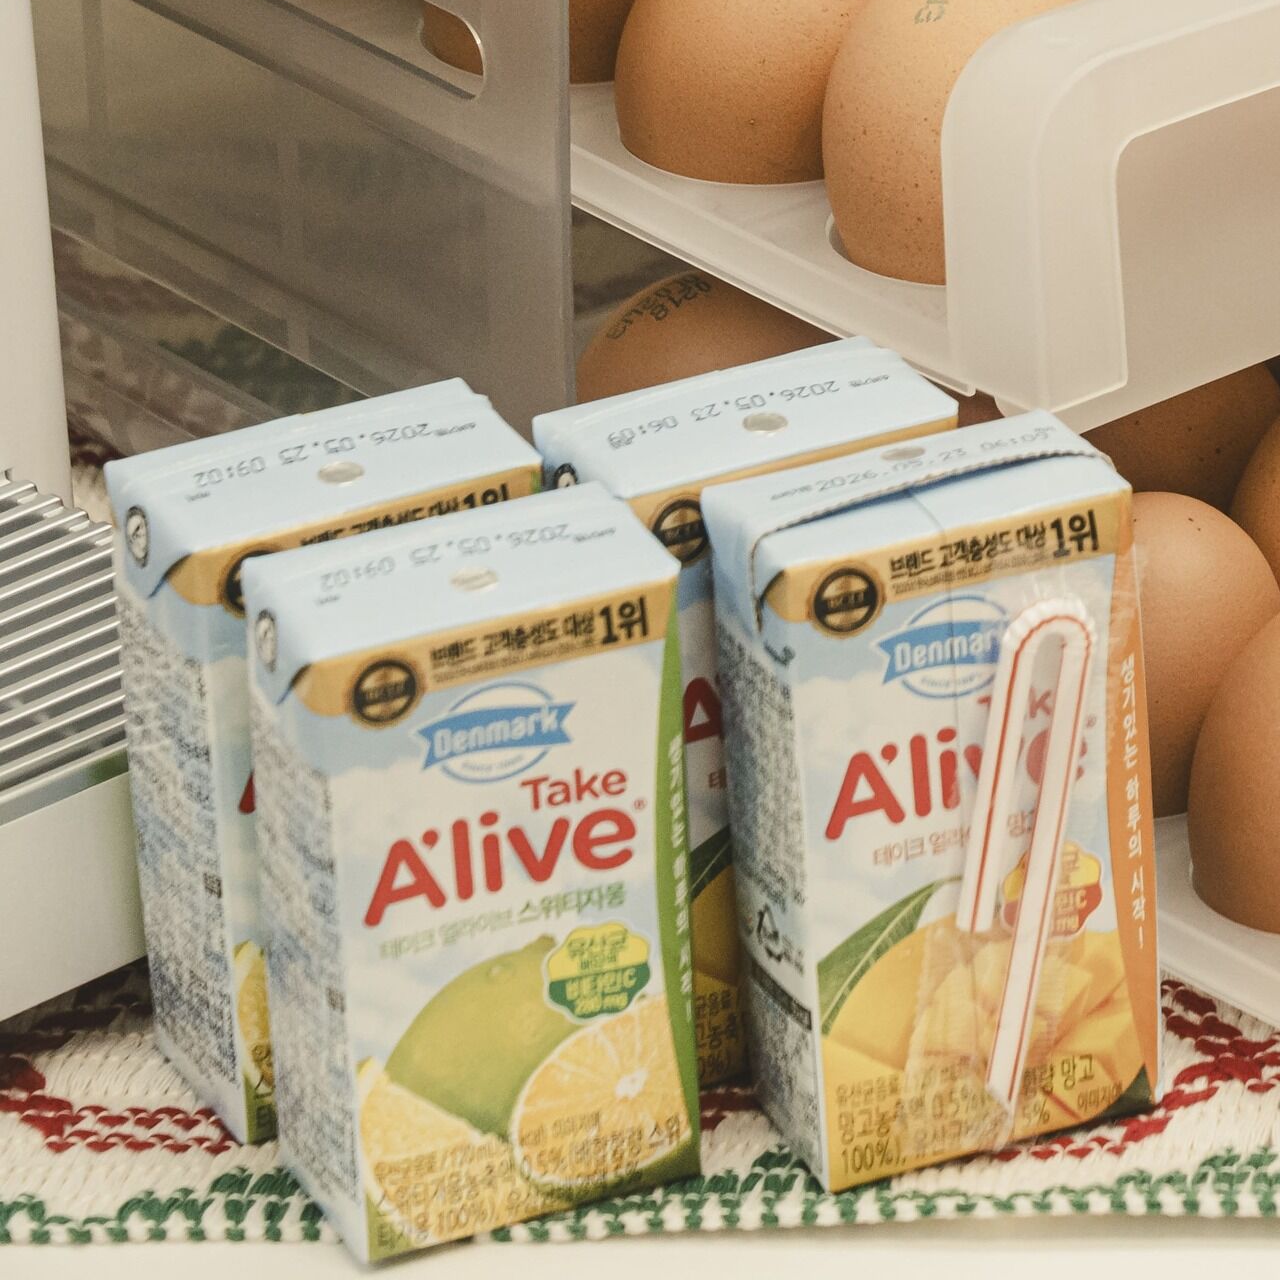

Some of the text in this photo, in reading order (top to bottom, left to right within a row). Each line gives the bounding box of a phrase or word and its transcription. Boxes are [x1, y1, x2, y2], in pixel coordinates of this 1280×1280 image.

[690, 380, 840, 422] 2026.05.23
[194, 423, 429, 489] 2026.05.25 09:02
[409, 523, 571, 567] 2026.05.25
[1050, 508, 1100, 558] 1위
[319, 556, 397, 591] 09:02
[599, 594, 649, 645] 1위
[894, 624, 997, 673] Denmar
[432, 704, 560, 759] Denmark
[520, 767, 627, 811] Take
[1121, 652, 1147, 950] 생기있는 하루의 시작!
[362, 808, 636, 927] A'live
[872, 836, 926, 868] 테이크
[516, 881, 627, 924] 스위티자몽
[1060, 1053, 1095, 1091] 망고
